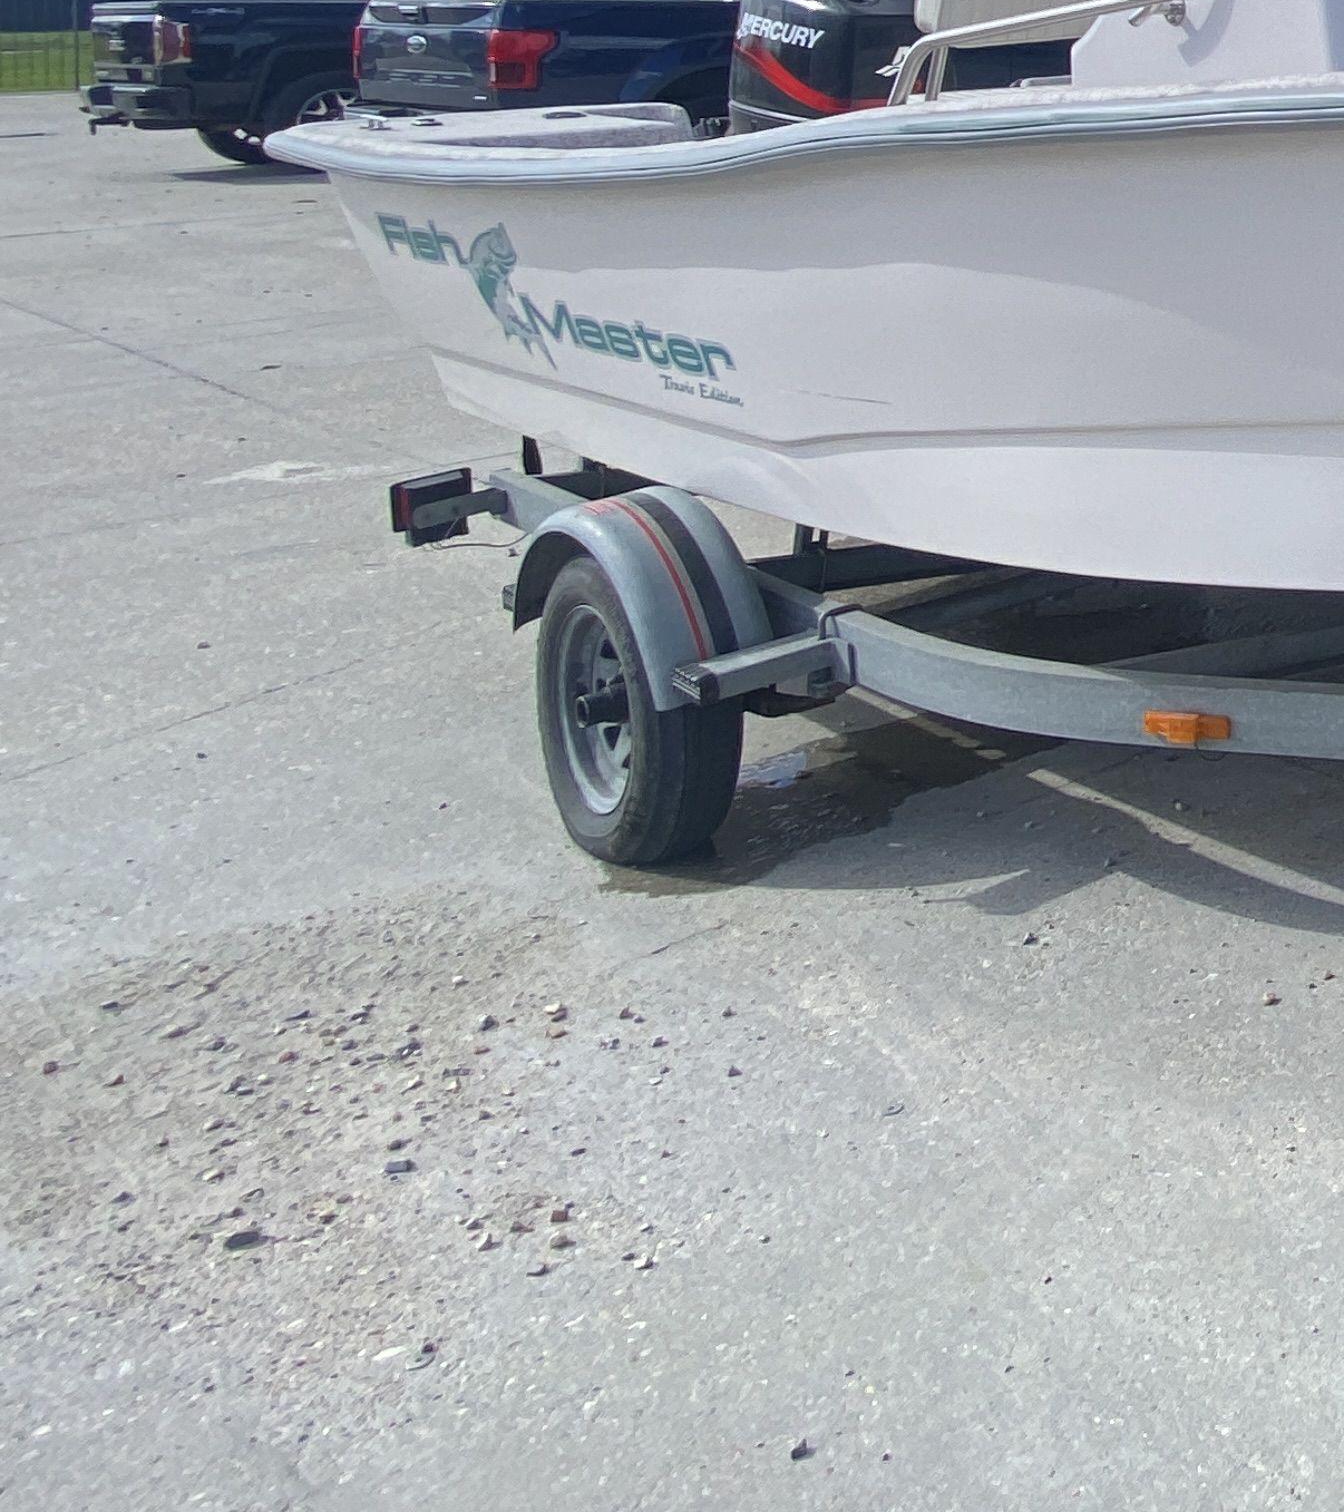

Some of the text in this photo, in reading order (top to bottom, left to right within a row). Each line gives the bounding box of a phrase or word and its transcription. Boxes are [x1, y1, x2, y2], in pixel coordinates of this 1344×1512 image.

[741, 12, 825, 49] MERCURY
[375, 212, 468, 267] Fish
[517, 292, 737, 381] Master
